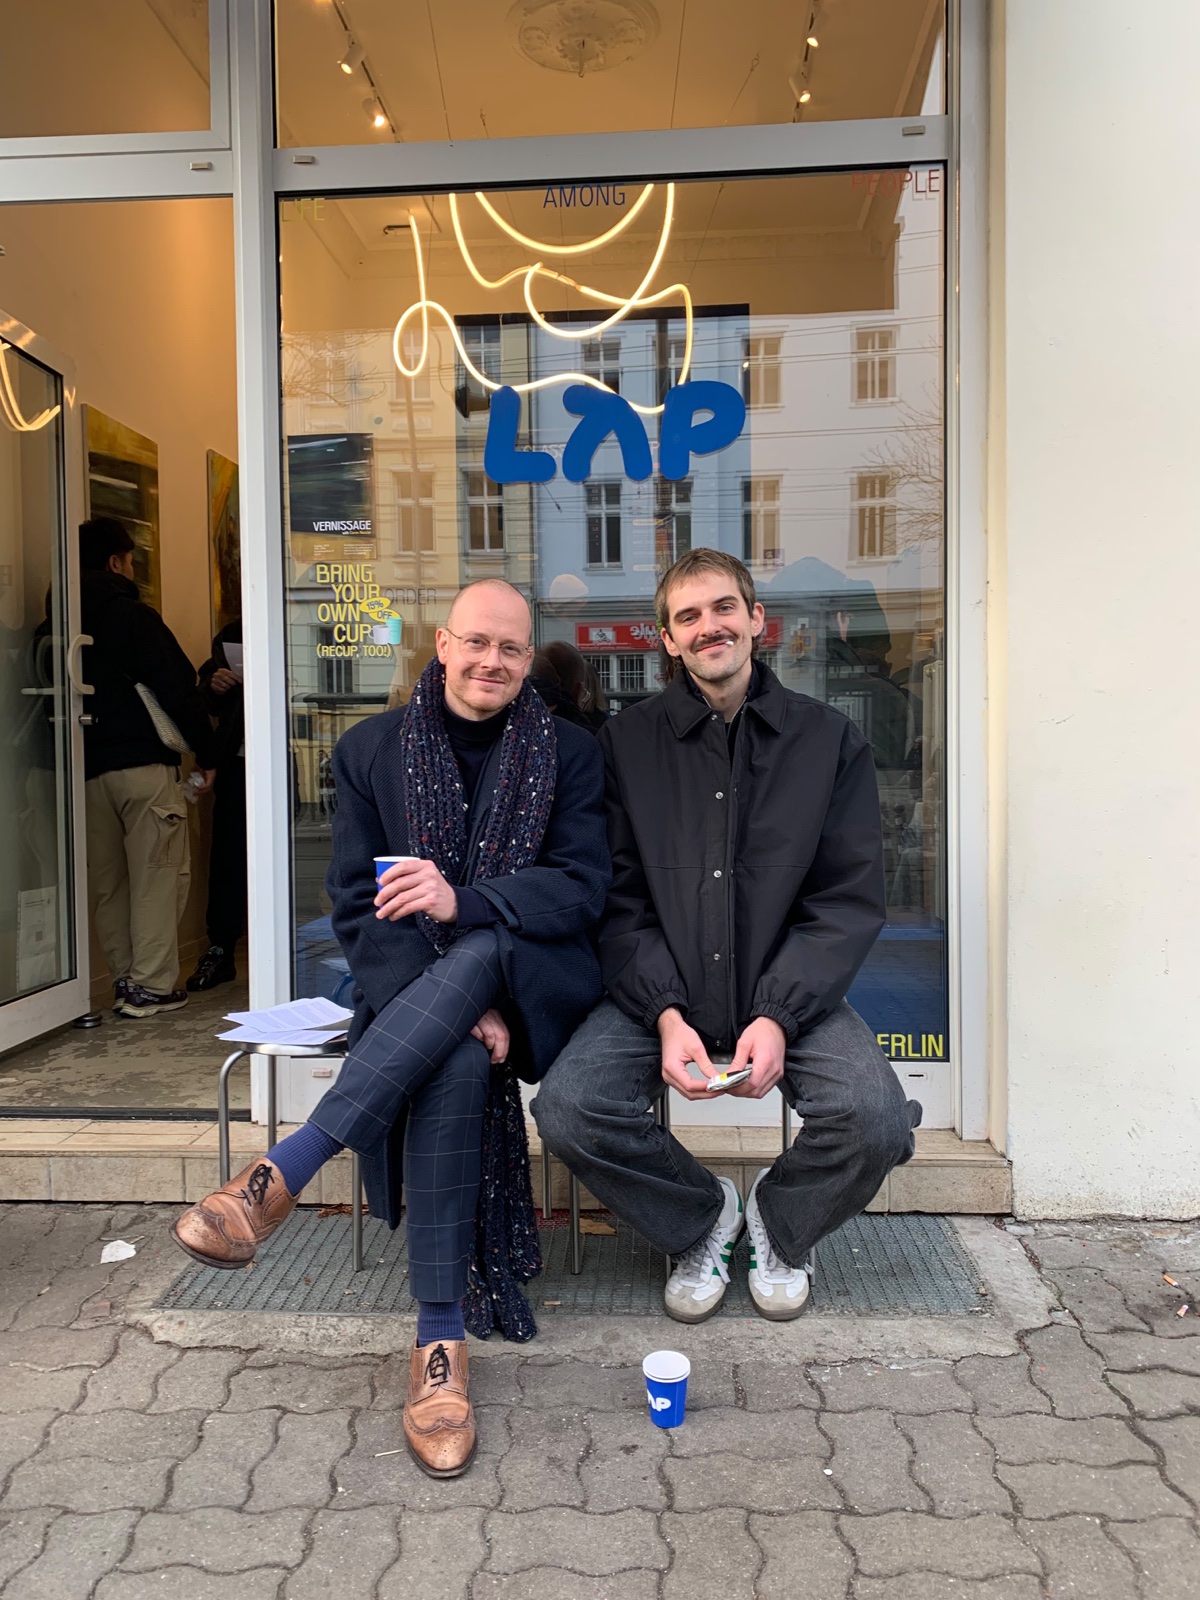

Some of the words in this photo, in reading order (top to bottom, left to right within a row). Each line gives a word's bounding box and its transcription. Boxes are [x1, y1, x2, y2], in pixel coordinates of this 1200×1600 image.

[850, 168, 941, 197] PEOPLE
[543, 182, 626, 209] AMONG
[484, 380, 747, 484] LAP
[312, 520, 372, 532] VERNISSAGE
[316, 563, 373, 583] BRING
[331, 583, 380, 603] YOUR
[384, 588, 437, 605] ORDER
[317, 603, 361, 622] OWN
[333, 623, 372, 643] CUP
[316, 643, 361, 659] (RECUP,
[362, 643, 392, 659] TOO!)
[876, 1033, 944, 1057] ERLIN
